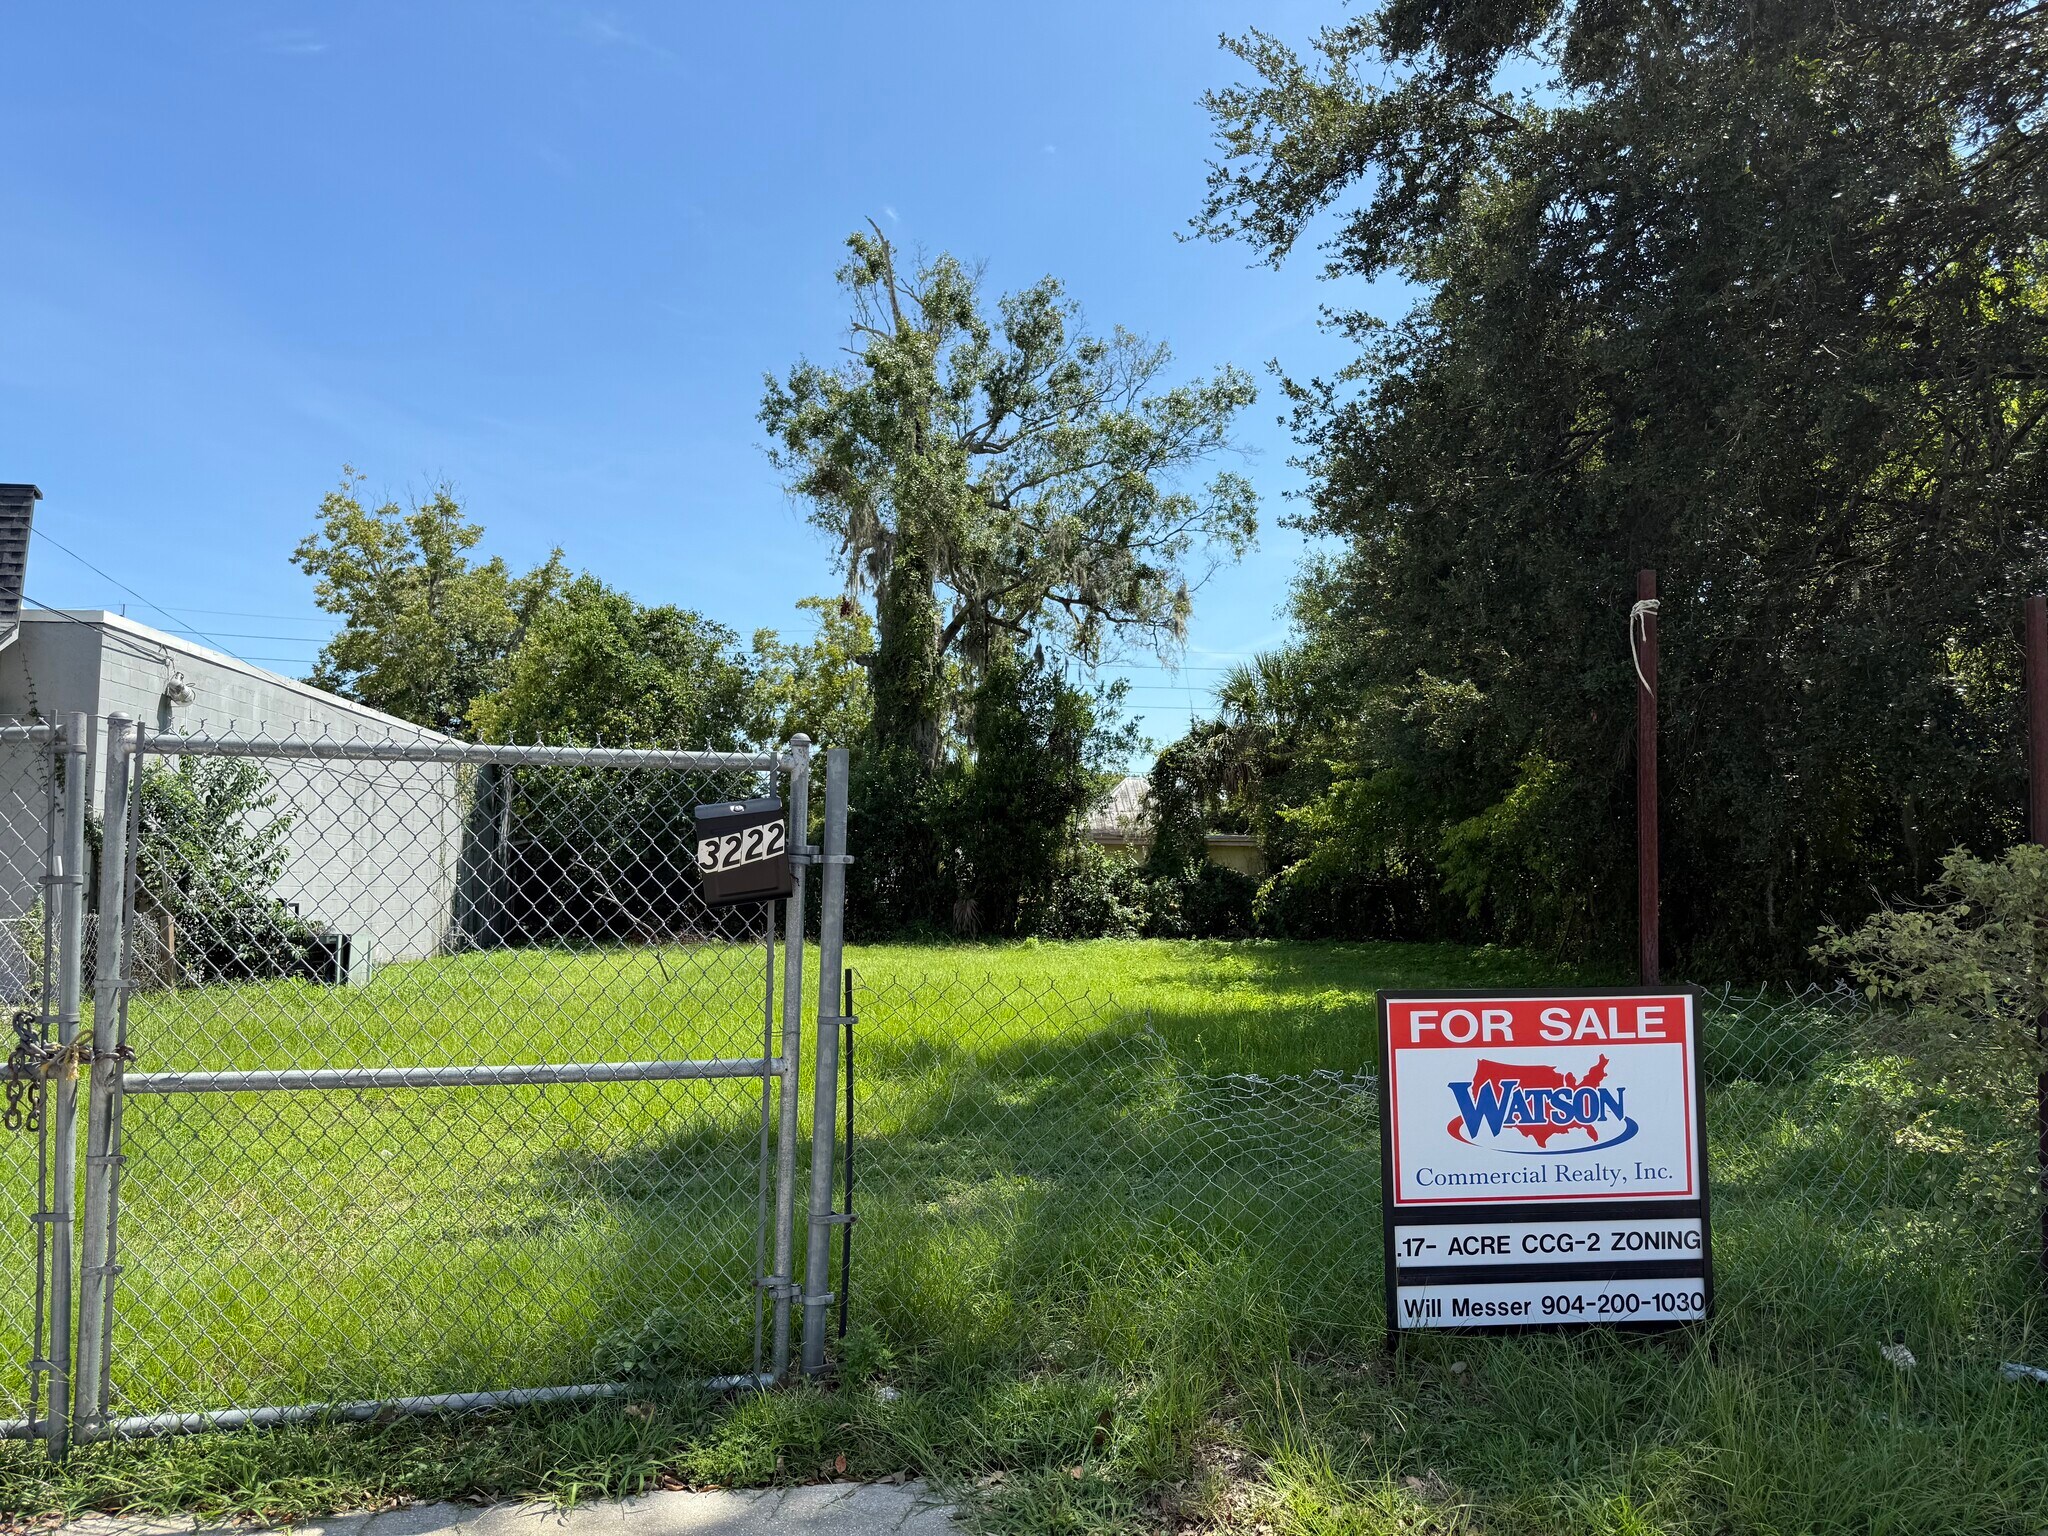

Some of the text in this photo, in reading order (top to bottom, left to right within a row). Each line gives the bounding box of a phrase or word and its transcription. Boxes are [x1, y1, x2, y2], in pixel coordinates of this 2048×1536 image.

[700, 822, 785, 870] 3222
[1409, 1005, 1667, 1043] FOR SALE
[1447, 1080, 1626, 1140] WATSON
[1415, 1161, 1673, 1187] Commercial Realty, Inc.
[1397, 1230, 1701, 1257] .17- ACRE CCG-2 ZONING
[1404, 1292, 1705, 1318] Will Messer 904-200-1030
